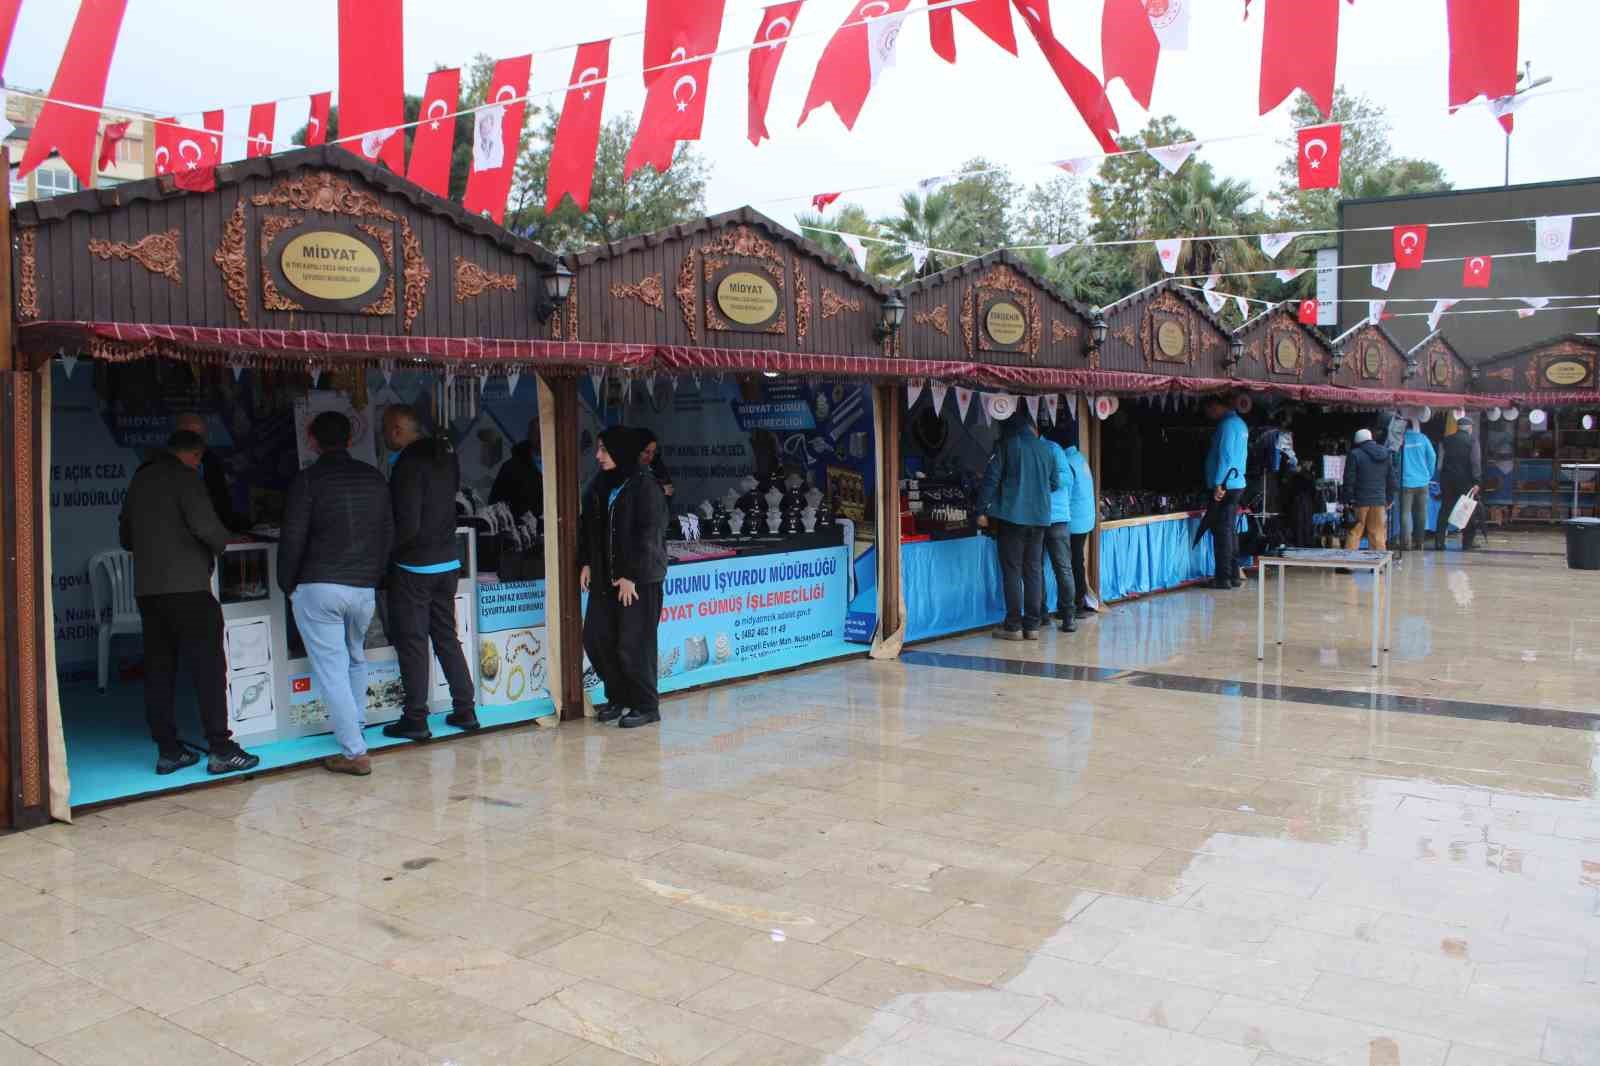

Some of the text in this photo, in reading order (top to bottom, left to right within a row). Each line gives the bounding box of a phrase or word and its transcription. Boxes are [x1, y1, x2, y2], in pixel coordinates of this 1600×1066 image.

[303, 244, 358, 260] MİDYAT
[729, 282, 763, 295] MİDYAT
[64, 464, 92, 486] AÇIK
[95, 463, 127, 480] CEZA
[663, 557, 837, 597] URUMU İŞYURDU MÜDÜRLÜĞÜ
[481, 594, 496, 605] CEZA
[698, 594, 743, 618] GÜMÜŞ
[746, 582, 825, 612] İŞLEMECİLİĞİ
